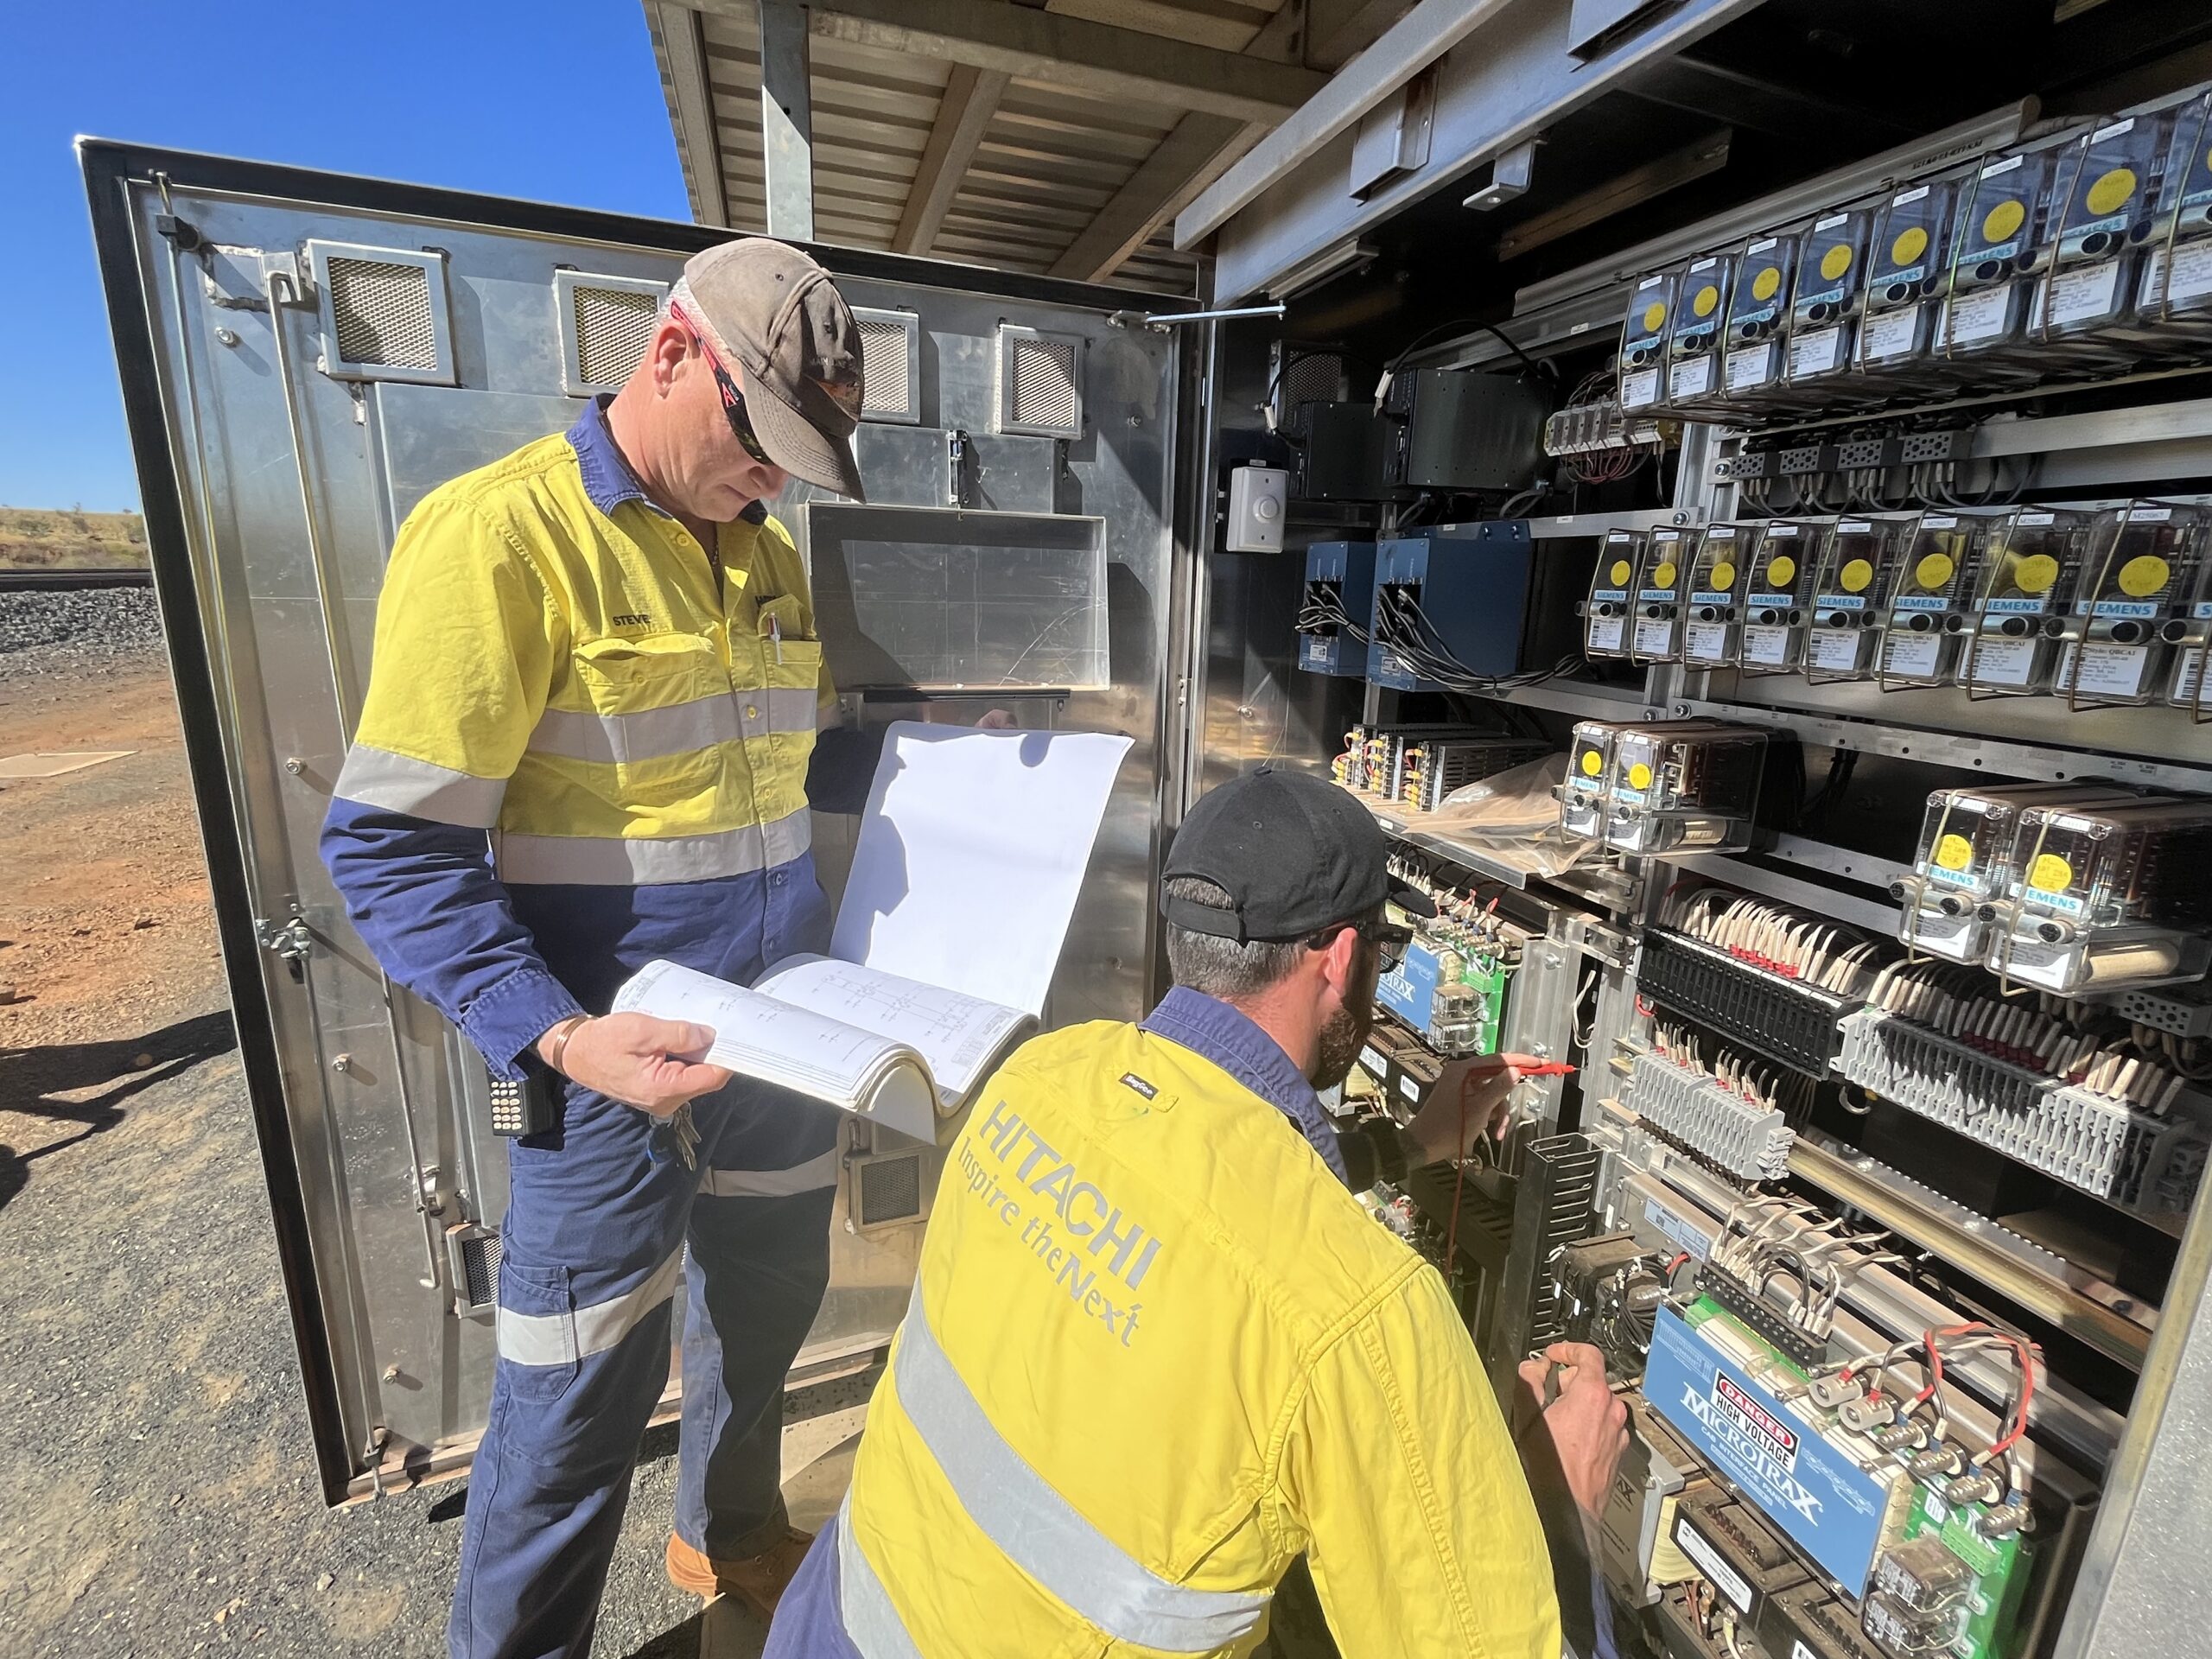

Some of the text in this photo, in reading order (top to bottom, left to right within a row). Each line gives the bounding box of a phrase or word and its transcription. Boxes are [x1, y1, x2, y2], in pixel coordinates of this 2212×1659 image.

[1596, 591, 1624, 600] SIEMENS
[1642, 591, 1673, 600] SIEMENS
[1694, 594, 1728, 603] SIEMENS
[1751, 595, 1789, 605] SIEMENS
[1817, 597, 1861, 607] SIEMENS
[1988, 601, 2040, 611] IEMENS
[613, 614, 651, 626] STEVE
[979, 1100, 1163, 1291] HITACHI
[957, 1136, 1021, 1227] Inspire
[1020, 1217, 1061, 1273] the
[1056, 1252, 1145, 1348] Next
[1725, 1384, 1791, 1445] DANGER
[1716, 1395, 1790, 1468] HIGH VOLTAGE
[1700, 1426, 1717, 1446] CAB
[1719, 1440, 1760, 1485] INTERFACE
[1762, 1477, 1788, 1510] PANEL
